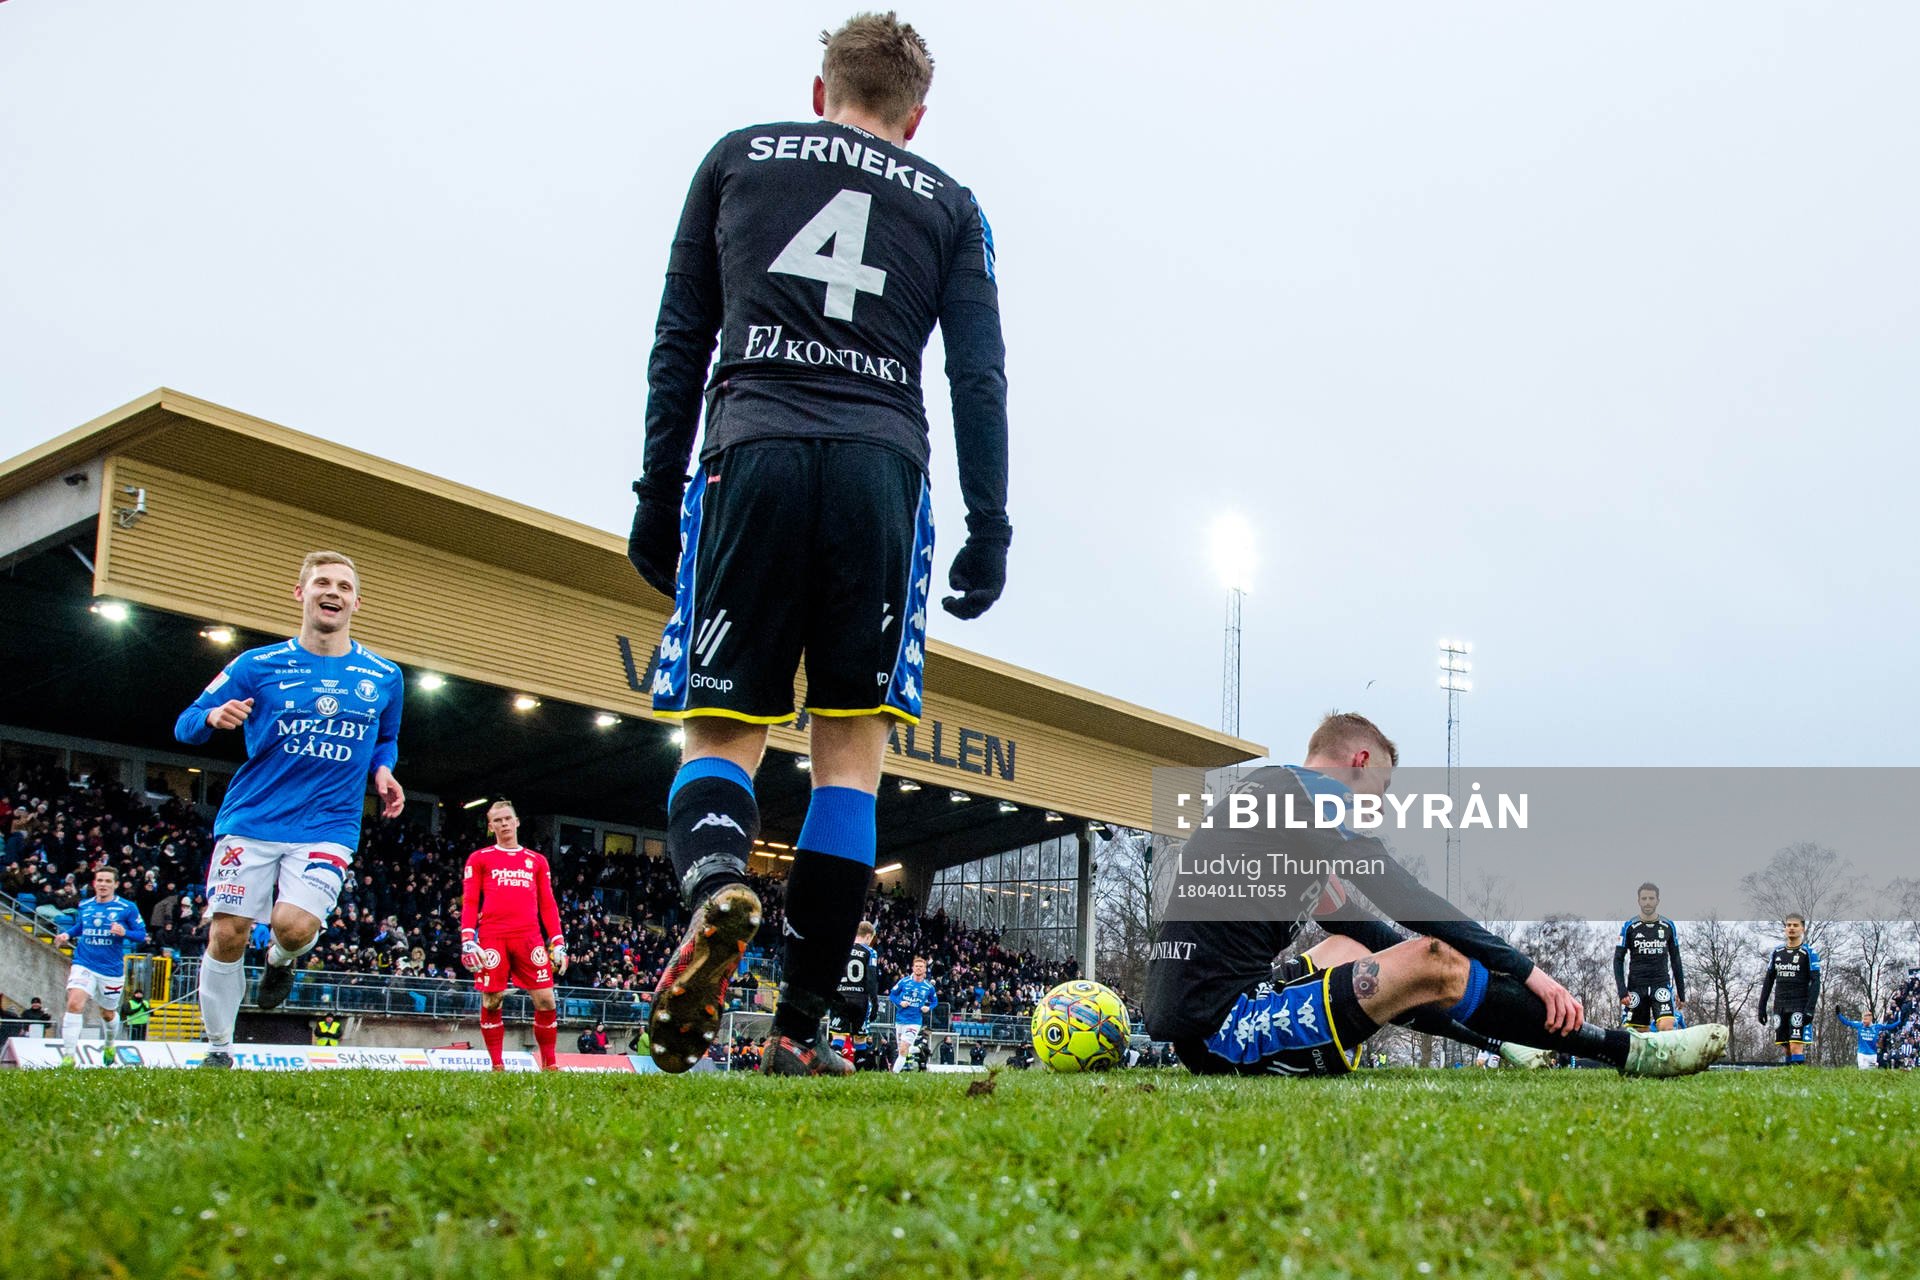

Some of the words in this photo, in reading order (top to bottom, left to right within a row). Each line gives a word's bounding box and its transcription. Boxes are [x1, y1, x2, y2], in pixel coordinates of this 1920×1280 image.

[748, 136, 940, 199] SERNEKE
[767, 189, 887, 322] 4
[744, 325, 783, 359] El
[690, 673, 733, 693] Group
[283, 735, 352, 762] GÅRD
[497, 877, 530, 888] Finans
[536, 969, 549, 979] 12
[1660, 1003, 1670, 1012] 26
[235, 1053, 304, 1067] T-Line
[439, 1056, 518, 1066] TRELLEBGS
